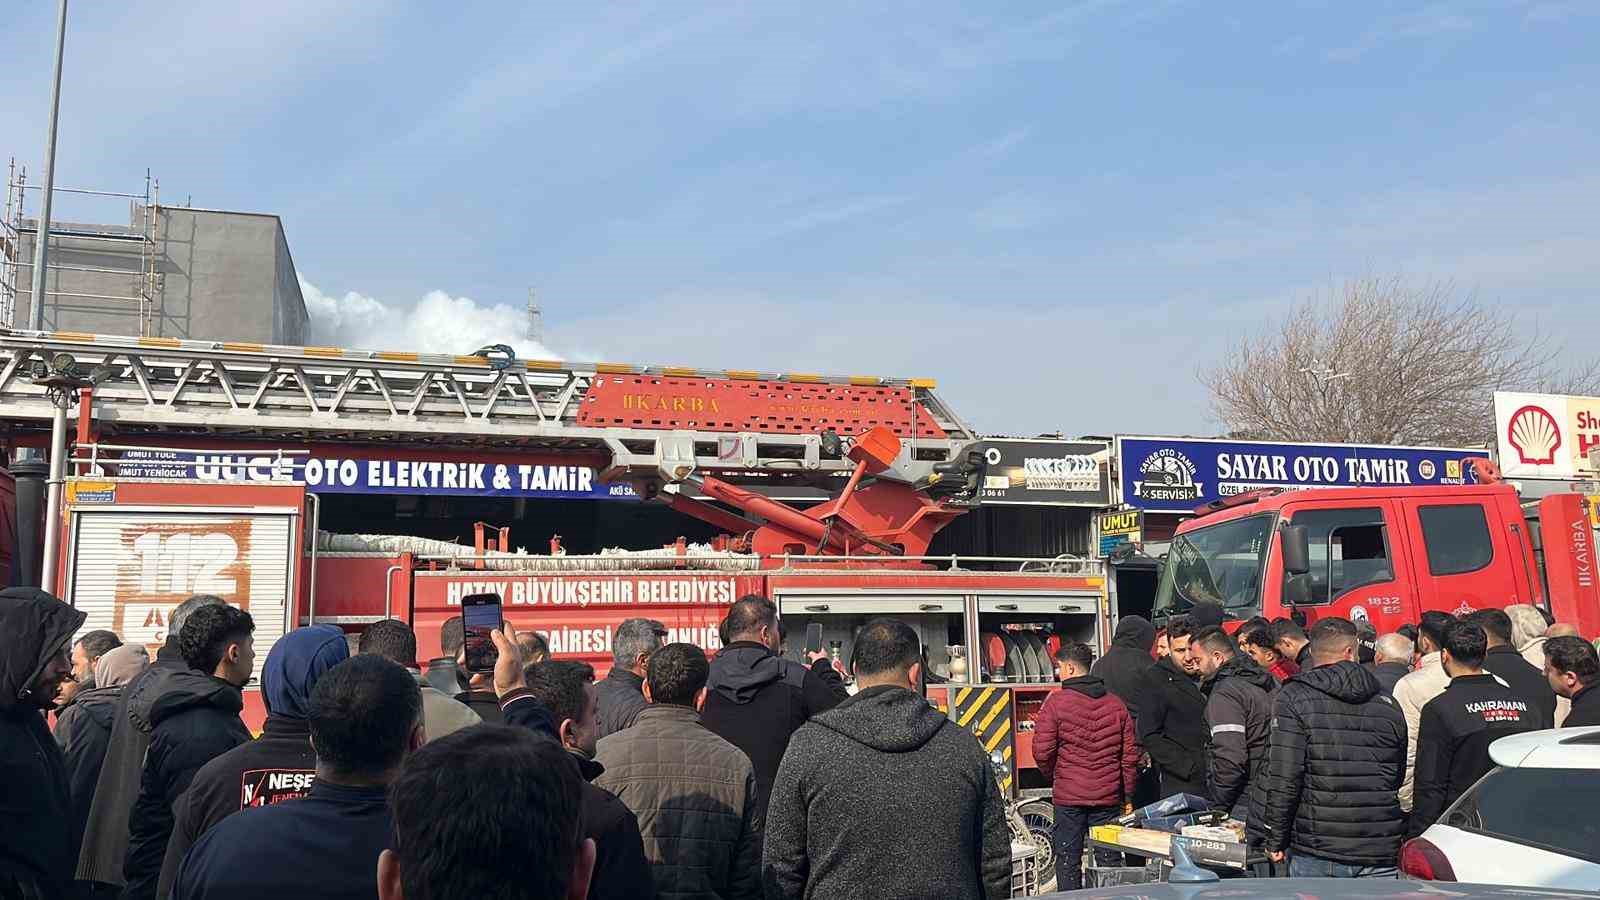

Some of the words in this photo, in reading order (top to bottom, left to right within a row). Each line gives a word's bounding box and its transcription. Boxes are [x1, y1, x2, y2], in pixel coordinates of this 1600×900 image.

[1577, 410, 1600, 429] Sh
[304, 459, 359, 486] OTO
[493, 464, 511, 490] &
[1140, 451, 1159, 474] SAYAR
[1159, 448, 1175, 457] OTO
[1216, 453, 1289, 482] SAYAR
[1293, 455, 1339, 483] OTO
[1103, 512, 1138, 530] UMUT
[134, 532, 238, 594] 112
[511, 576, 634, 608] BÜYÜKŞEHİR
[637, 577, 737, 605] BELEDİYESİ
[546, 625, 611, 654] AİRESİ
[1465, 700, 1528, 713] KAHRAMAN
[1190, 839, 1227, 850] 10-283
